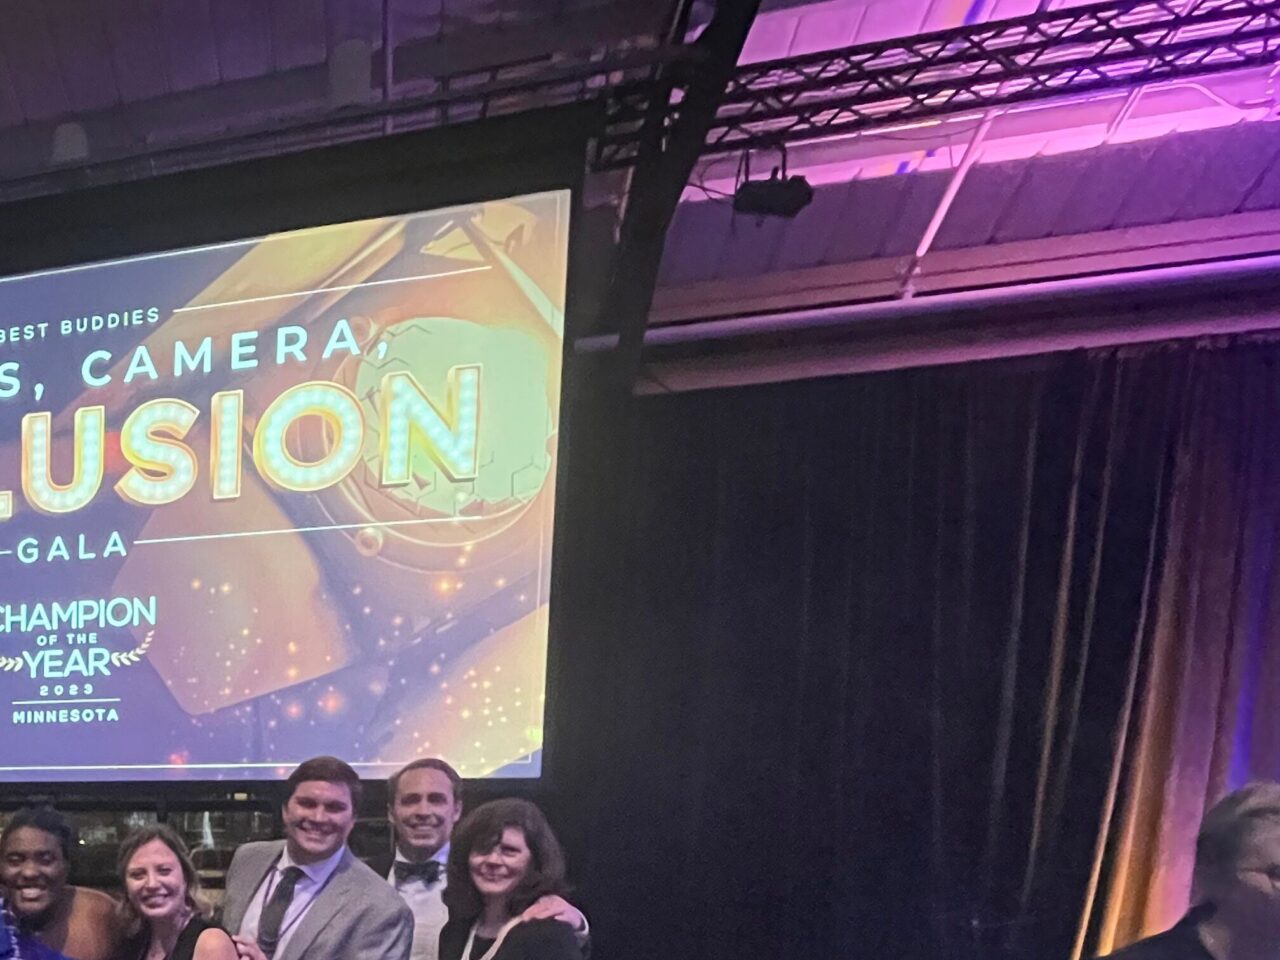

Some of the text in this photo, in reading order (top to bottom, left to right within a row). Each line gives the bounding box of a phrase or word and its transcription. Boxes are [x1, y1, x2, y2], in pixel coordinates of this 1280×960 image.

[60, 307, 160, 335] BUDDIES
[80, 318, 388, 388] CAMERA,
[16, 530, 128, 563] GALA
[36, 632, 98, 646] OF THE
[22, 647, 112, 679] YEAR
[39, 683, 94, 696] 2023
[12, 708, 119, 724] MINNESOTA
